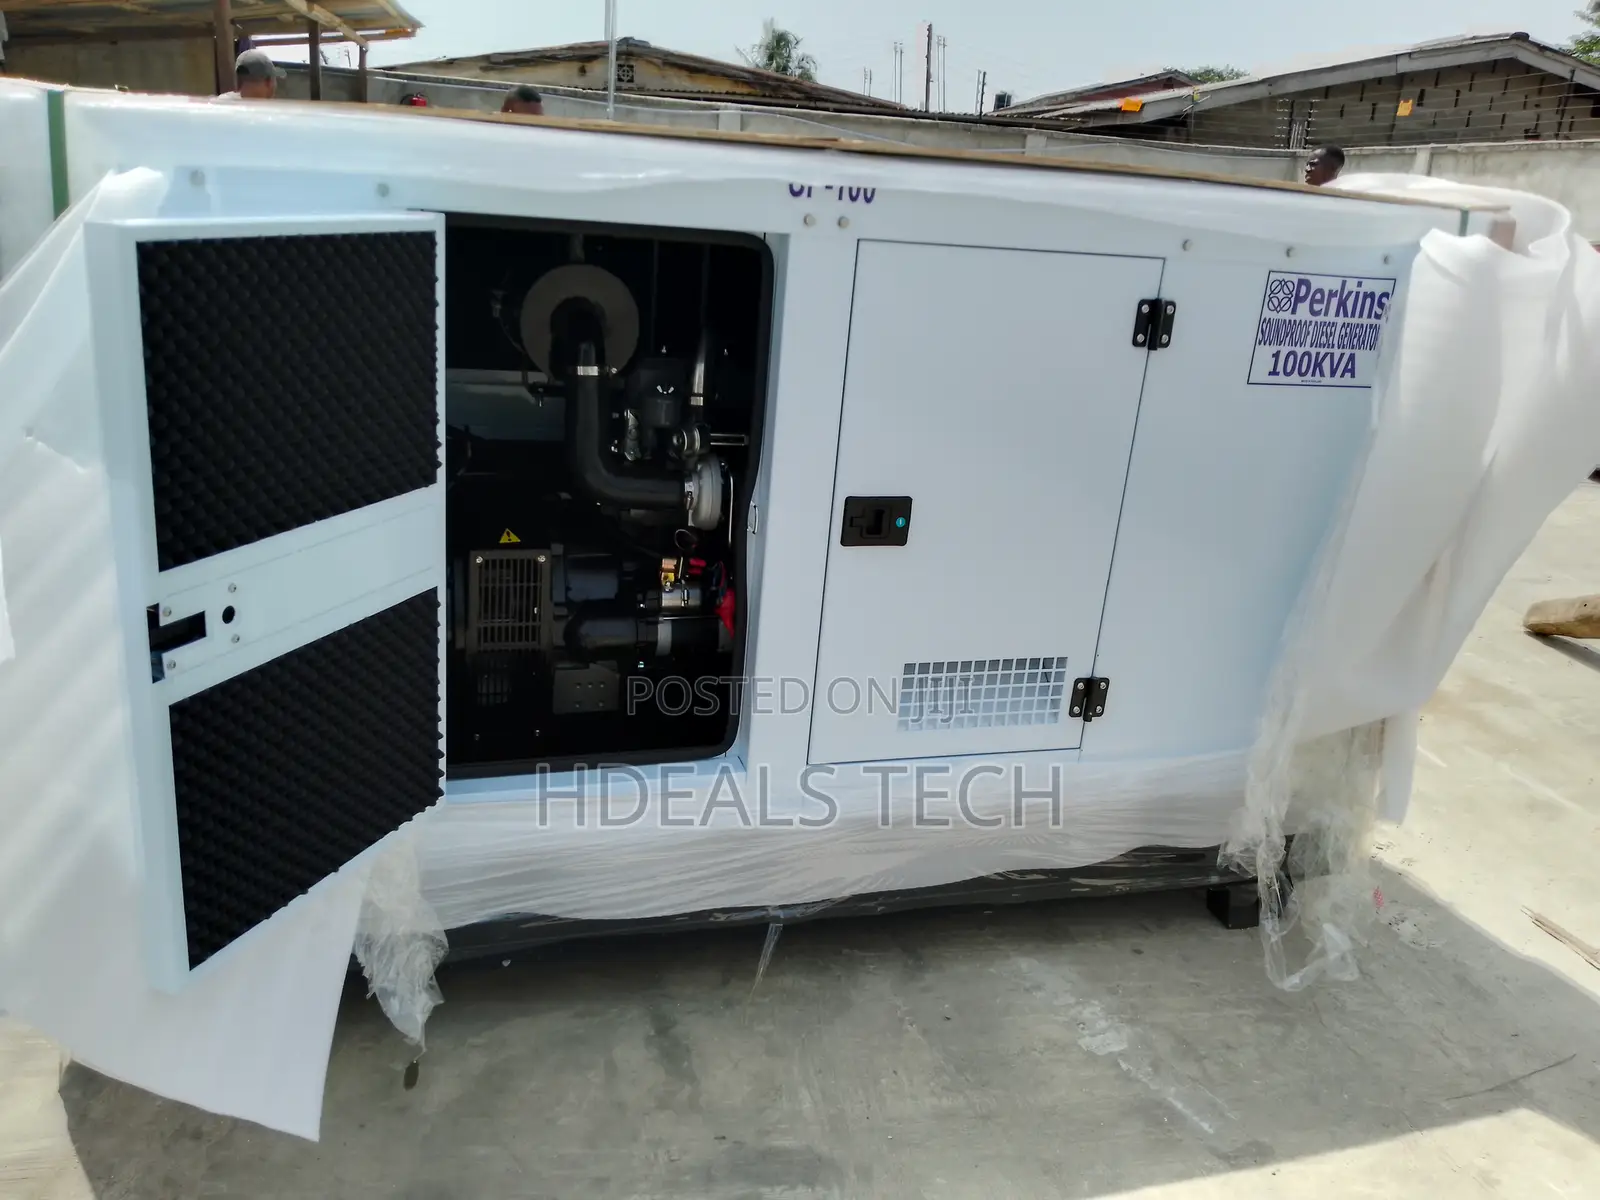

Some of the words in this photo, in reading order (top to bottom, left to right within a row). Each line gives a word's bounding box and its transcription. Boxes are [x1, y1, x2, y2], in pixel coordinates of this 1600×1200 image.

[1291, 278, 1390, 320] Perkins
[1258, 317, 1312, 348] SOUNDPROOF
[1310, 321, 1338, 349] DIESEL
[1268, 350, 1356, 378] 100KVA
